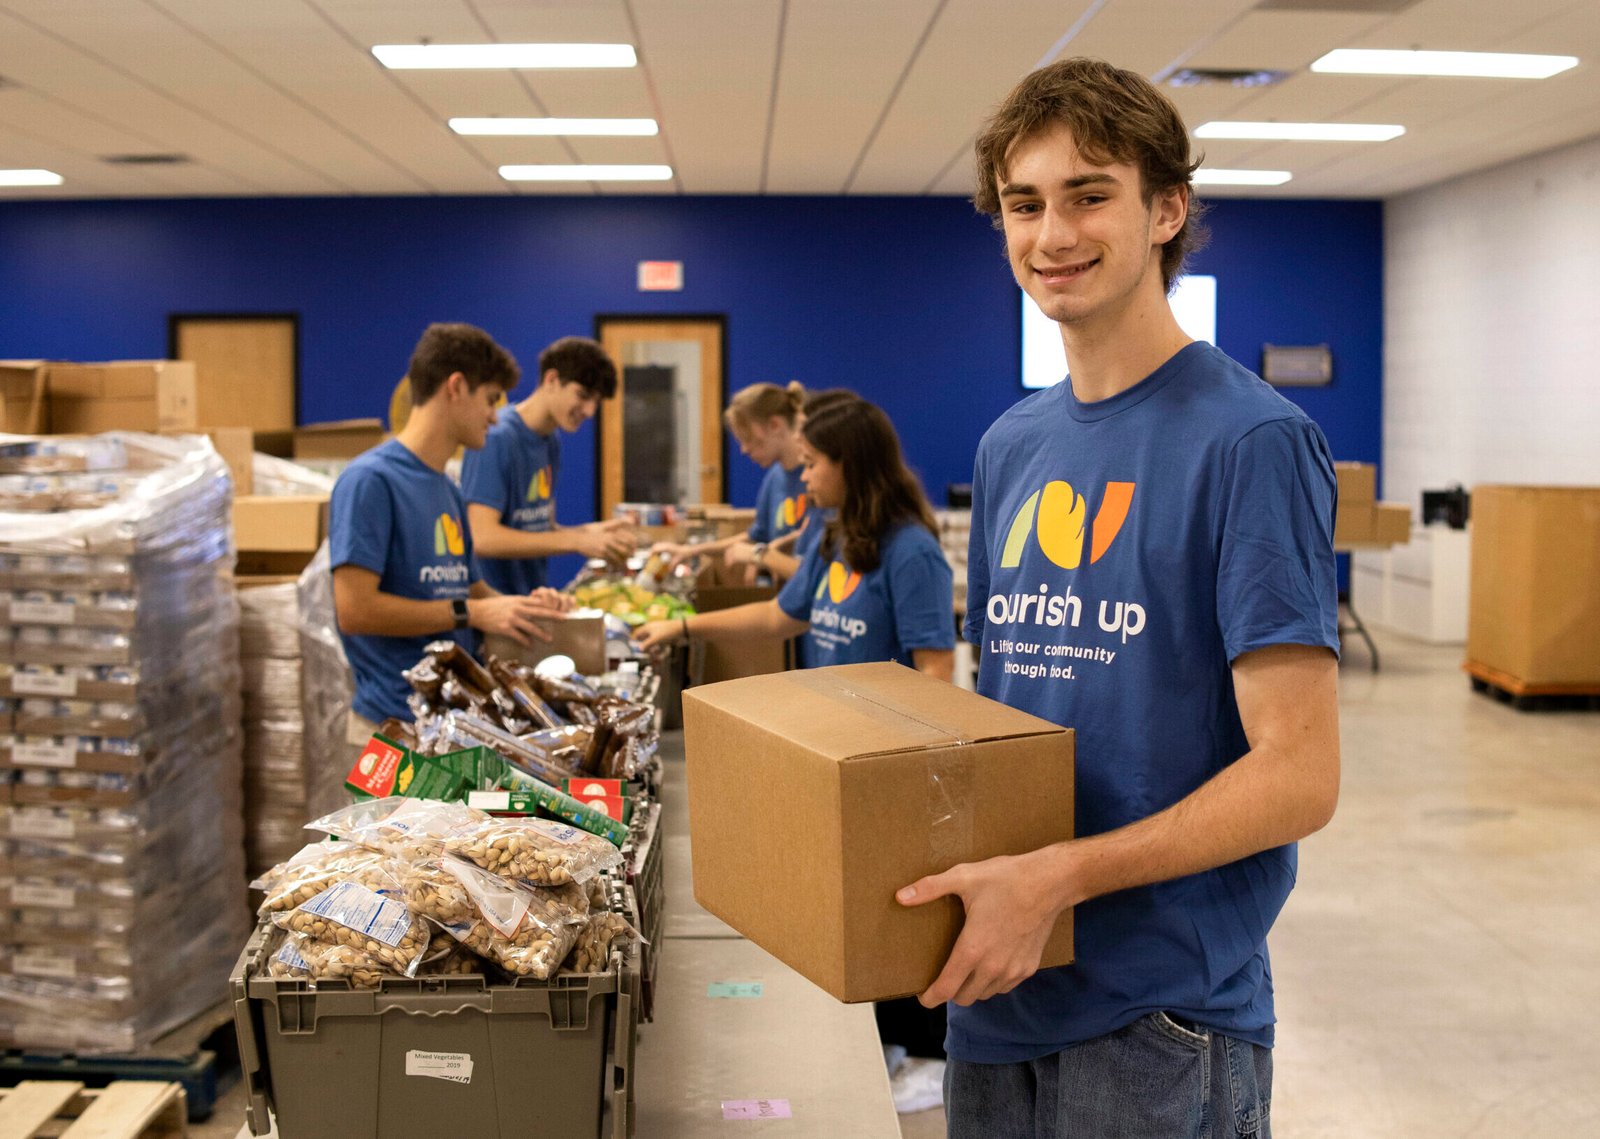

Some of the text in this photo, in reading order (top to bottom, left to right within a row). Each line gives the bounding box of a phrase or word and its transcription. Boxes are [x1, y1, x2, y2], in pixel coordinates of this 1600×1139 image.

[987, 583, 1147, 644] ourish up
[840, 615, 867, 639] up
[1015, 642, 1040, 655] our
